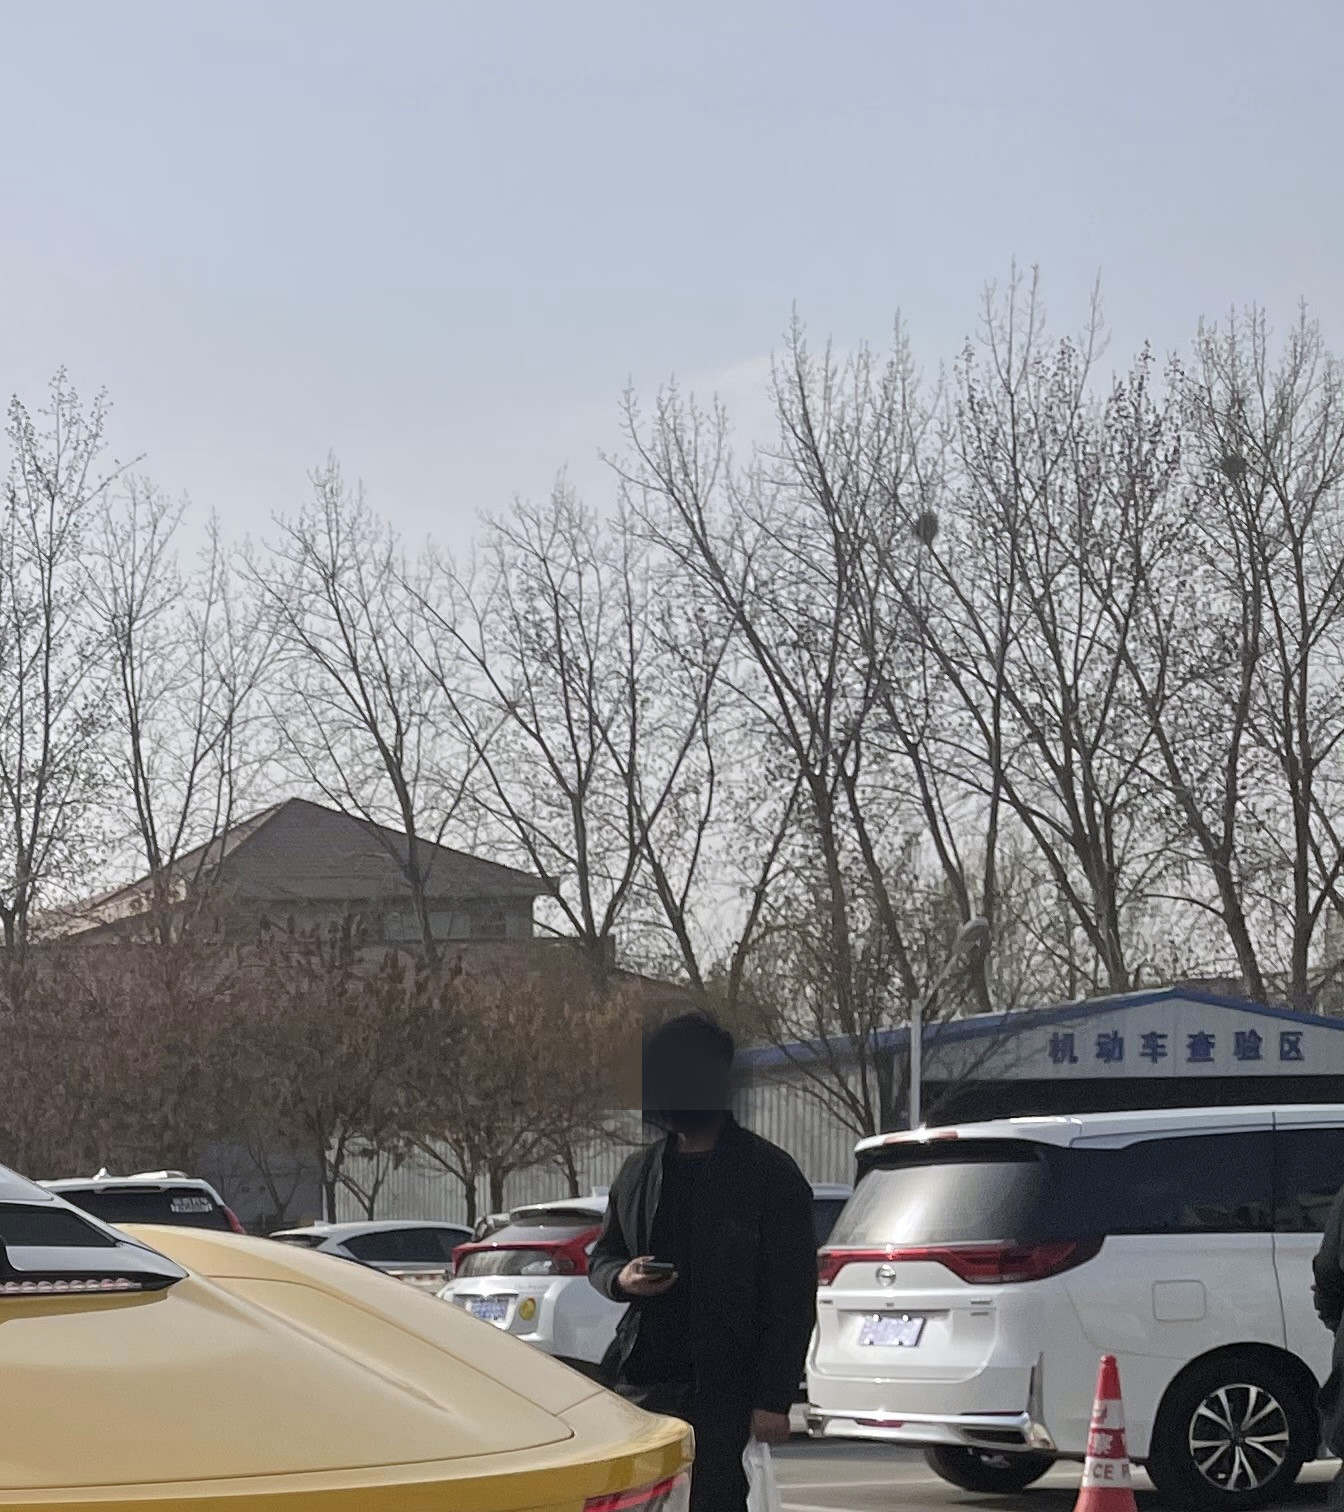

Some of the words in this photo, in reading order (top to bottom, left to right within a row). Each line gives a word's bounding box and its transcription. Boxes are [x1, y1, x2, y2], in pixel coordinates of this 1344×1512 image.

[1048, 1029, 1305, 1064] 机动车查验区
